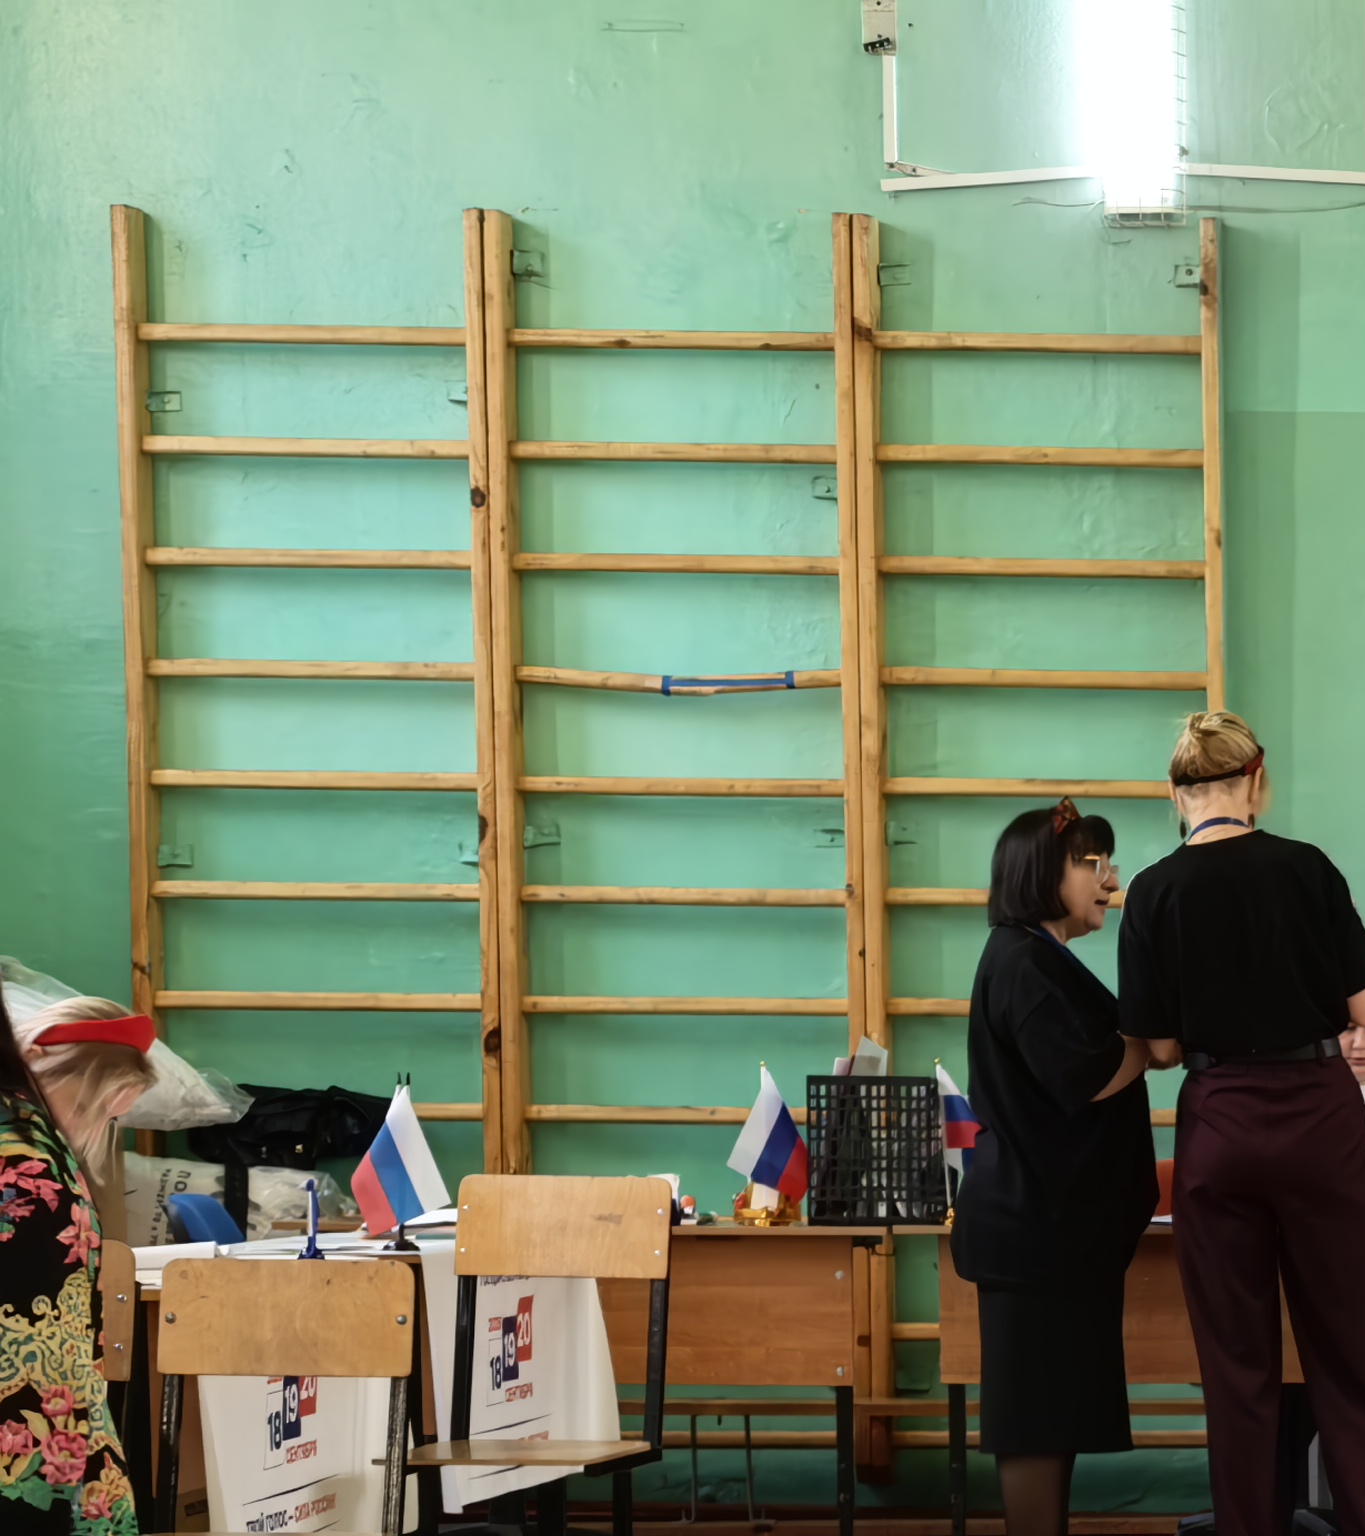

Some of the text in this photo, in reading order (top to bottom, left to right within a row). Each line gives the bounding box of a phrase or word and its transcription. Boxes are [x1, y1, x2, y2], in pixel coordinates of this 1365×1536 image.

[490, 1312, 531, 1391] 18 19 20
[267, 1410, 282, 1451] 18
[285, 1383, 299, 1424] 19
